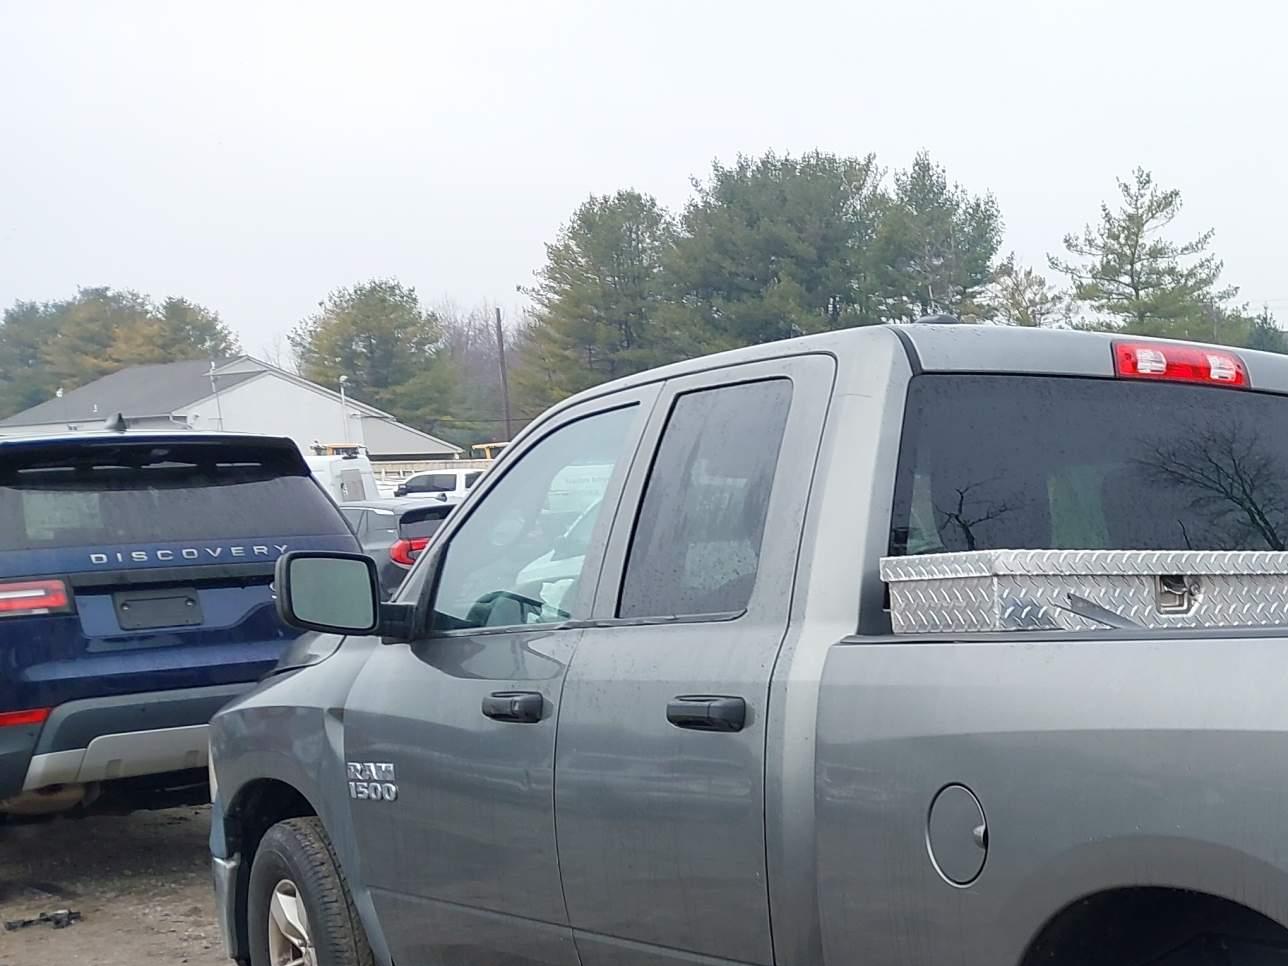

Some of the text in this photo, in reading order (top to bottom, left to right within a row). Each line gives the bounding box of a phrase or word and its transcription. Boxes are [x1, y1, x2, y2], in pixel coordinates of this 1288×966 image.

[89, 544, 288, 565] DISCOVERY
[346, 762, 395, 781] RAM
[348, 781, 397, 801] 1500
